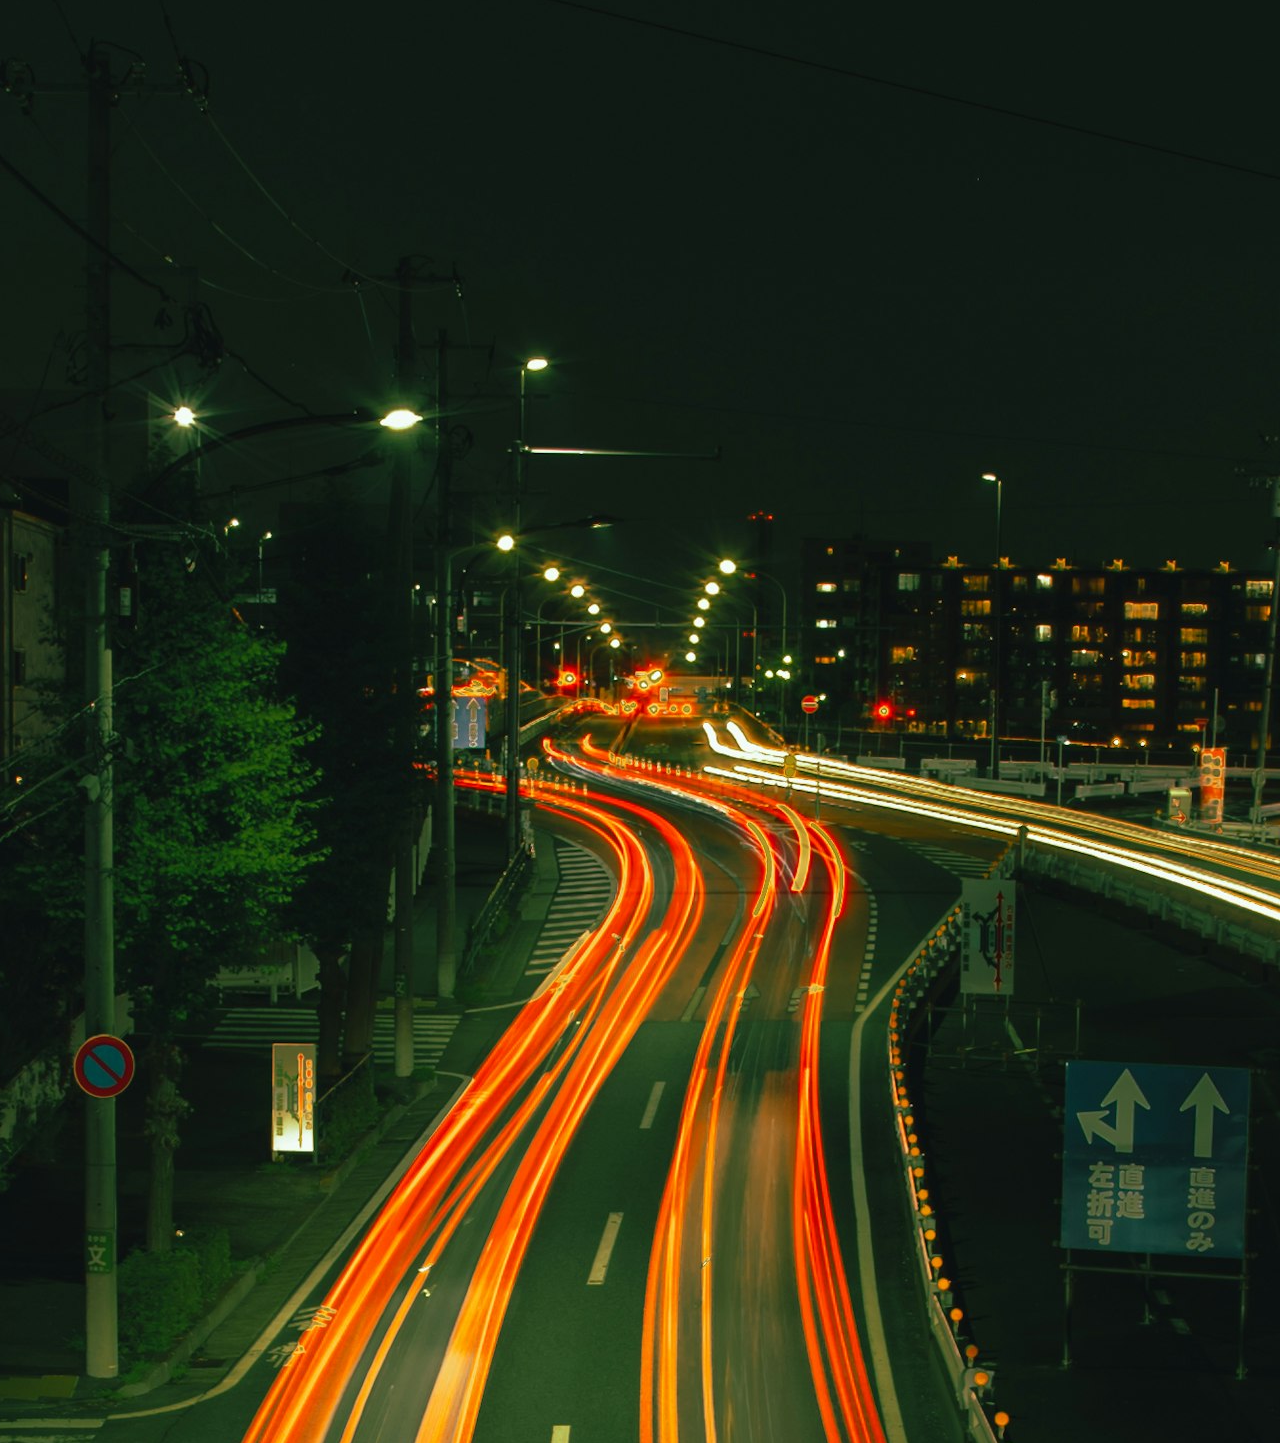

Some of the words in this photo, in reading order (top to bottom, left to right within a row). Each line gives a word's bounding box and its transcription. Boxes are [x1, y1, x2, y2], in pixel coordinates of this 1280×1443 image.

[1086, 1160, 1115, 1246] 左折可
[1116, 1163, 1145, 1220] 直進
[1185, 1167, 1216, 1253] 直進のみ
